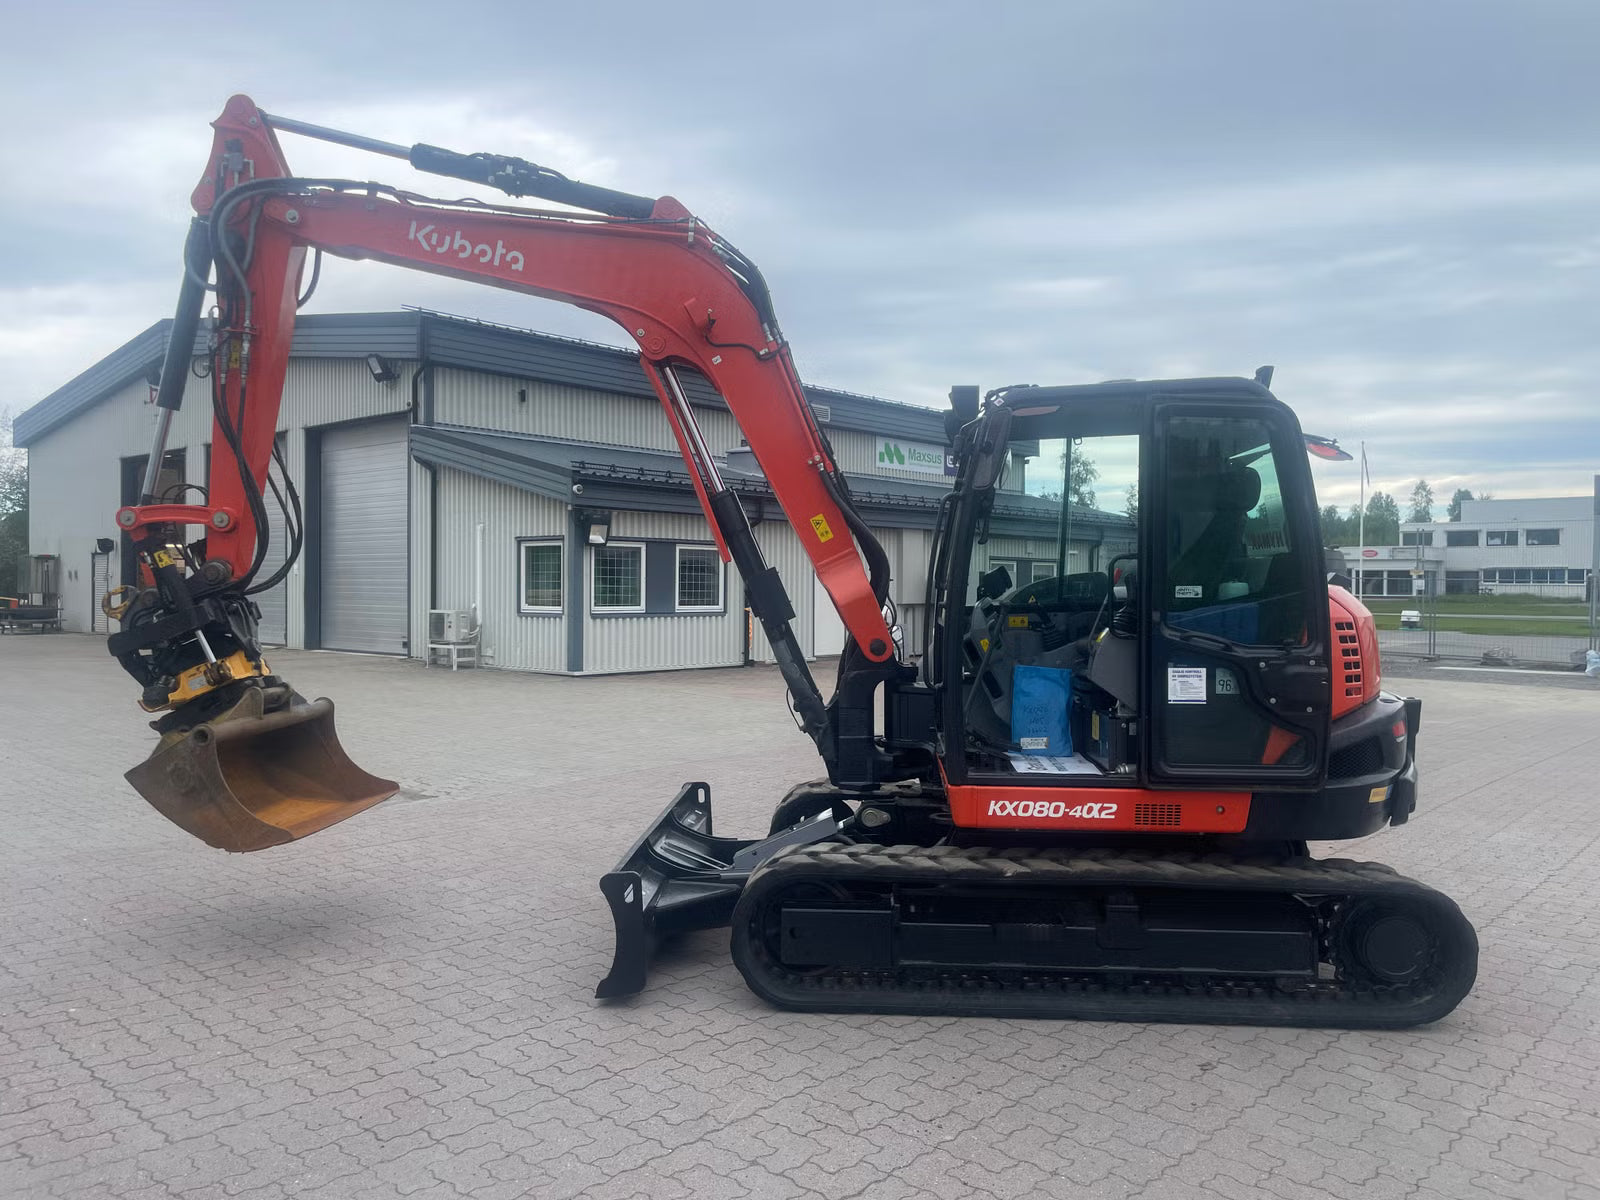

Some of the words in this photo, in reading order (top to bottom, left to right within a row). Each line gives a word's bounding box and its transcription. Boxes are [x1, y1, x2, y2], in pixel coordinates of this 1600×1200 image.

[408, 220, 525, 272] Kubota
[908, 447, 943, 465] Maxsus
[1218, 679, 1232, 692] 96
